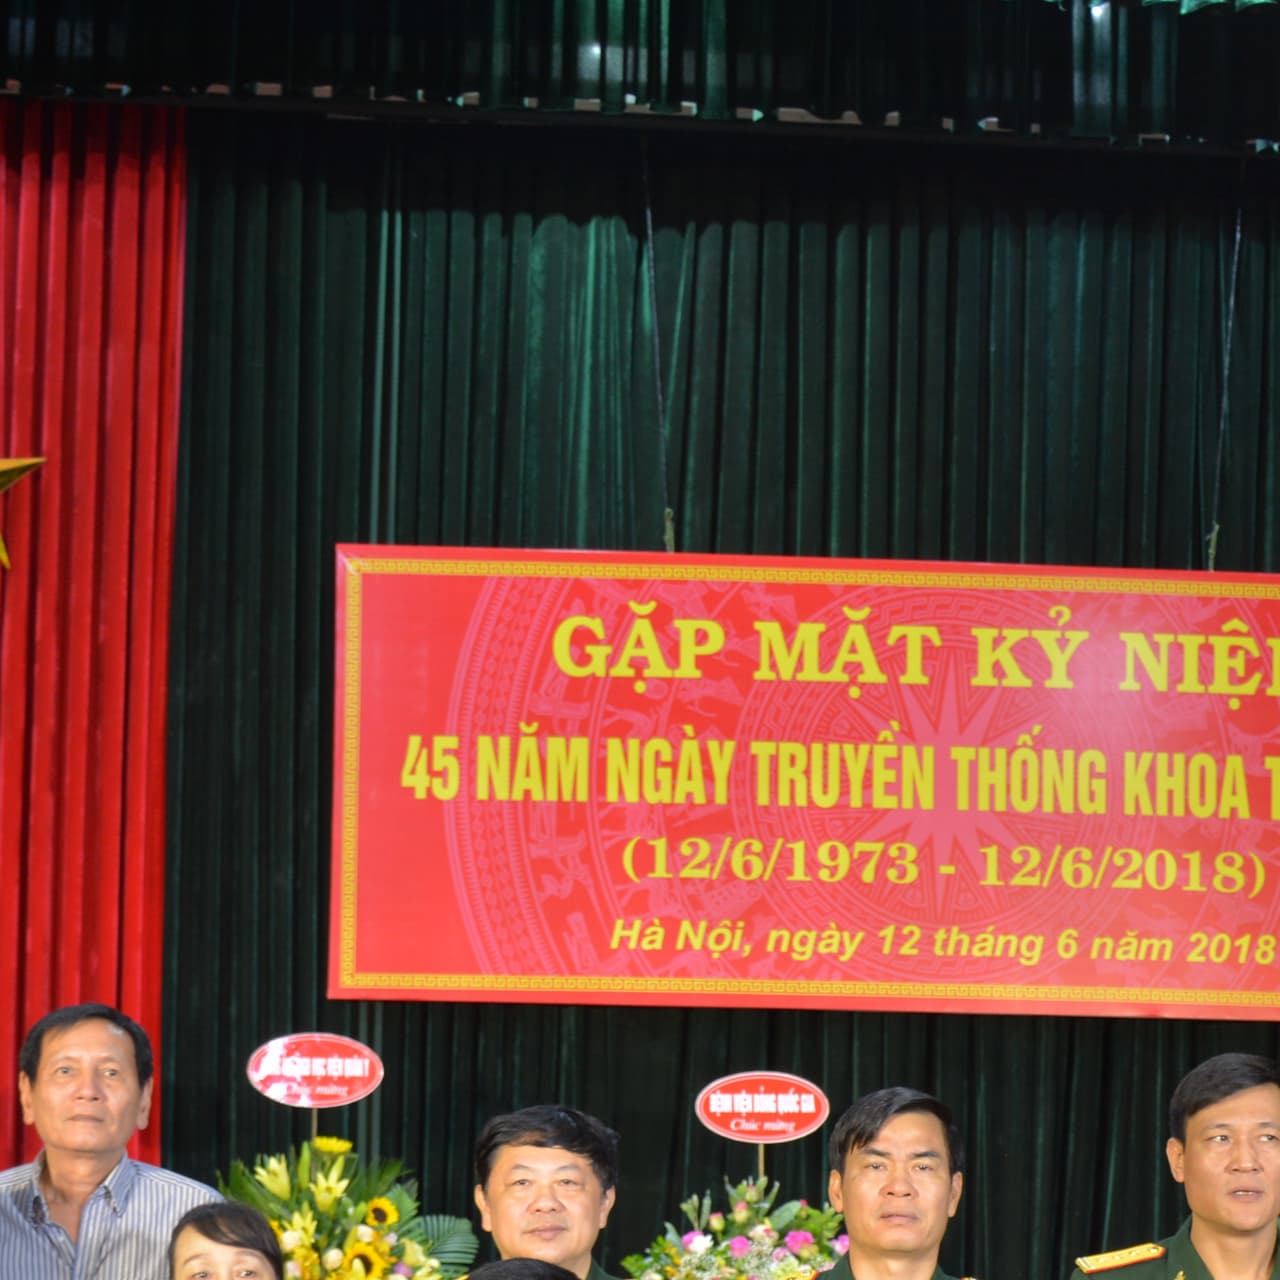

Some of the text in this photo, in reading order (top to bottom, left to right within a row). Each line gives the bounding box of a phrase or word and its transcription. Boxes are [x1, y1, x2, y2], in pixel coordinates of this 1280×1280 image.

[552, 599, 726, 693] GẶP
[753, 605, 942, 699] MẶT
[970, 605, 1090, 690] KỶ
[401, 735, 460, 801] 45
[476, 721, 590, 802] NĂM
[606, 724, 736, 805] NGÀY
[750, 721, 935, 811] TRUYỀN
[950, 724, 1108, 816] THỐNG
[1123, 751, 1251, 820] KHOA
[623, 836, 1265, 899] (12/6/1973 - 12/6/2018)
[610, 917, 1278, 967] Hà Nội, ngày 12 tháng 6 năm 2018
[729, 1118, 796, 1134] Chúc mừng
